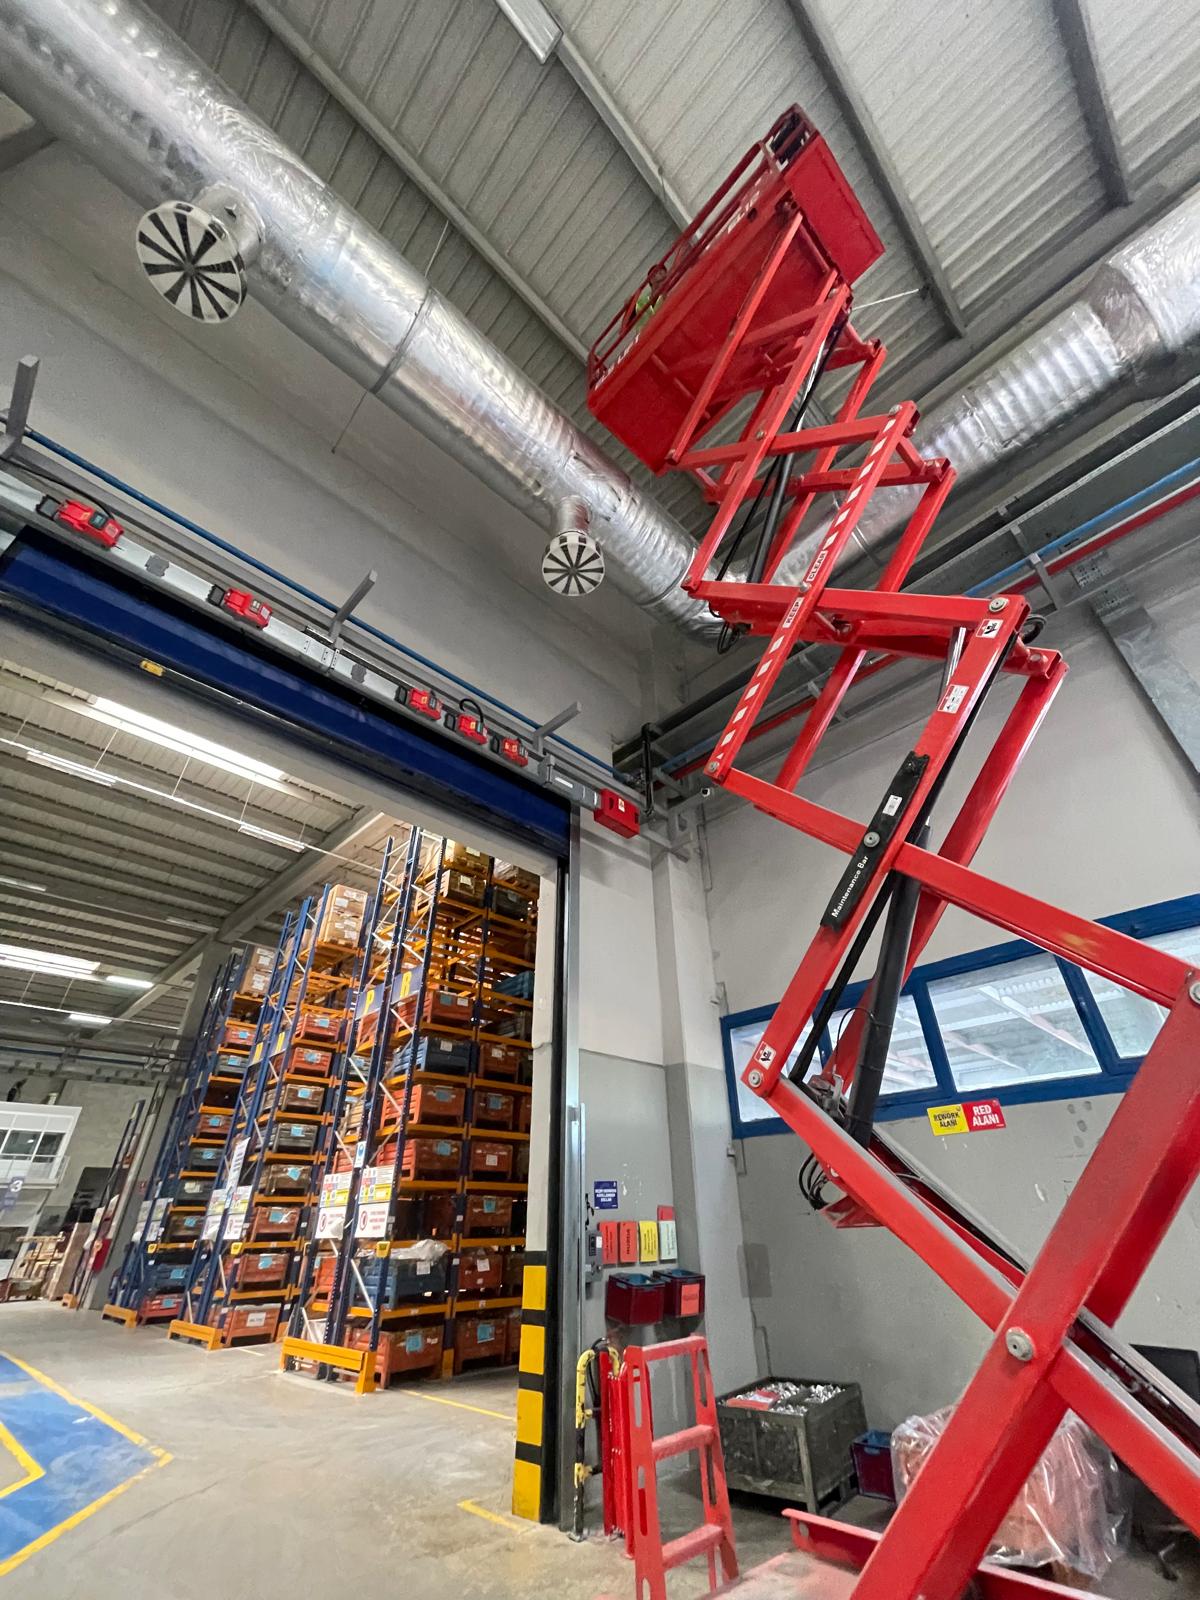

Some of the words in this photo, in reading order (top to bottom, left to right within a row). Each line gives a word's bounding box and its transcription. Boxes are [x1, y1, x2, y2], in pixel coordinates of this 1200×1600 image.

[786, 601, 800, 624] KEEP
[809, 553, 826, 580] CLEAR
[832, 870, 861, 917] Maintenance
[857, 856, 868, 868] Bar
[973, 1105, 991, 1115] RED
[934, 1112, 959, 1122] REWORK
[973, 1114, 999, 1126] ALANI
[939, 1119, 958, 1128] ALANI
[10, 1180, 23, 1192] 3
